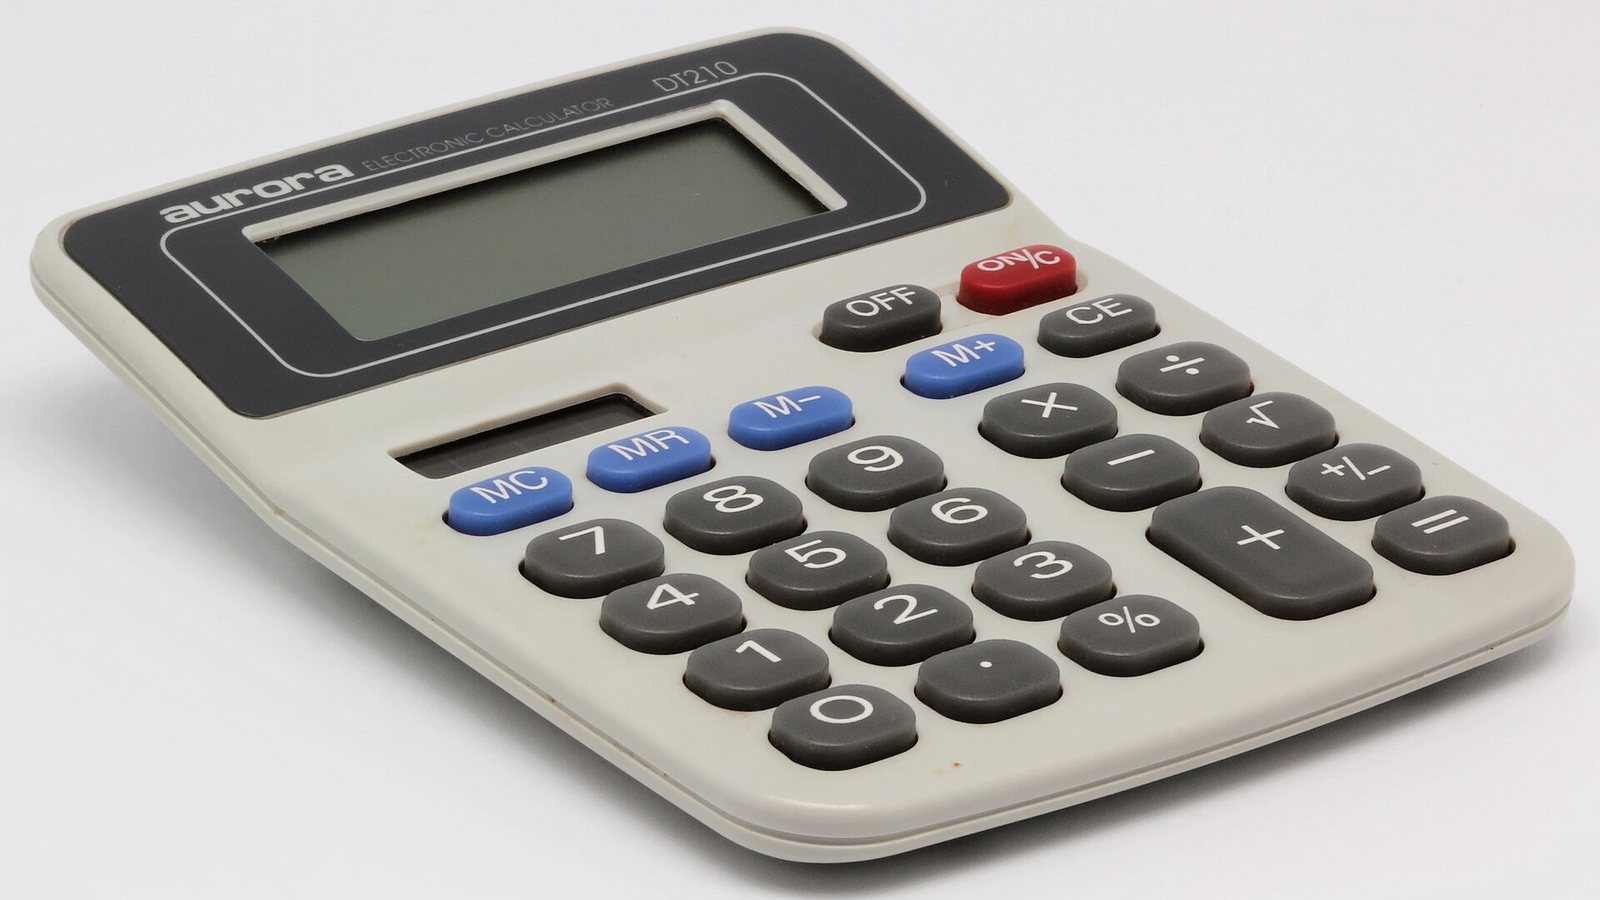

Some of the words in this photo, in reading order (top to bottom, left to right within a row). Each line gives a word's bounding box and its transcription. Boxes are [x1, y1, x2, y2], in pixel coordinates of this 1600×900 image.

[652, 60, 739, 93] DT210
[159, 162, 355, 224] aurora
[361, 130, 486, 172] ELECTRONIC
[486, 96, 614, 139] CALCULATOR
[976, 246, 1061, 273] ON/C
[844, 285, 918, 318] OFF
[1065, 295, 1133, 326] CE
[932, 337, 996, 368] M+
[607, 426, 690, 462] MR
[846, 445, 905, 473] 9
[469, 467, 549, 505] MC
[702, 483, 764, 514] 8
[931, 496, 990, 526] 6
[558, 524, 607, 556] 7
[784, 538, 848, 570] 5
[1013, 551, 1075, 580] 3
[646, 582, 701, 611] 4
[872, 593, 938, 626] 2
[1097, 604, 1162, 635] %
[735, 638, 783, 664] 1
[809, 693, 875, 725] 0
